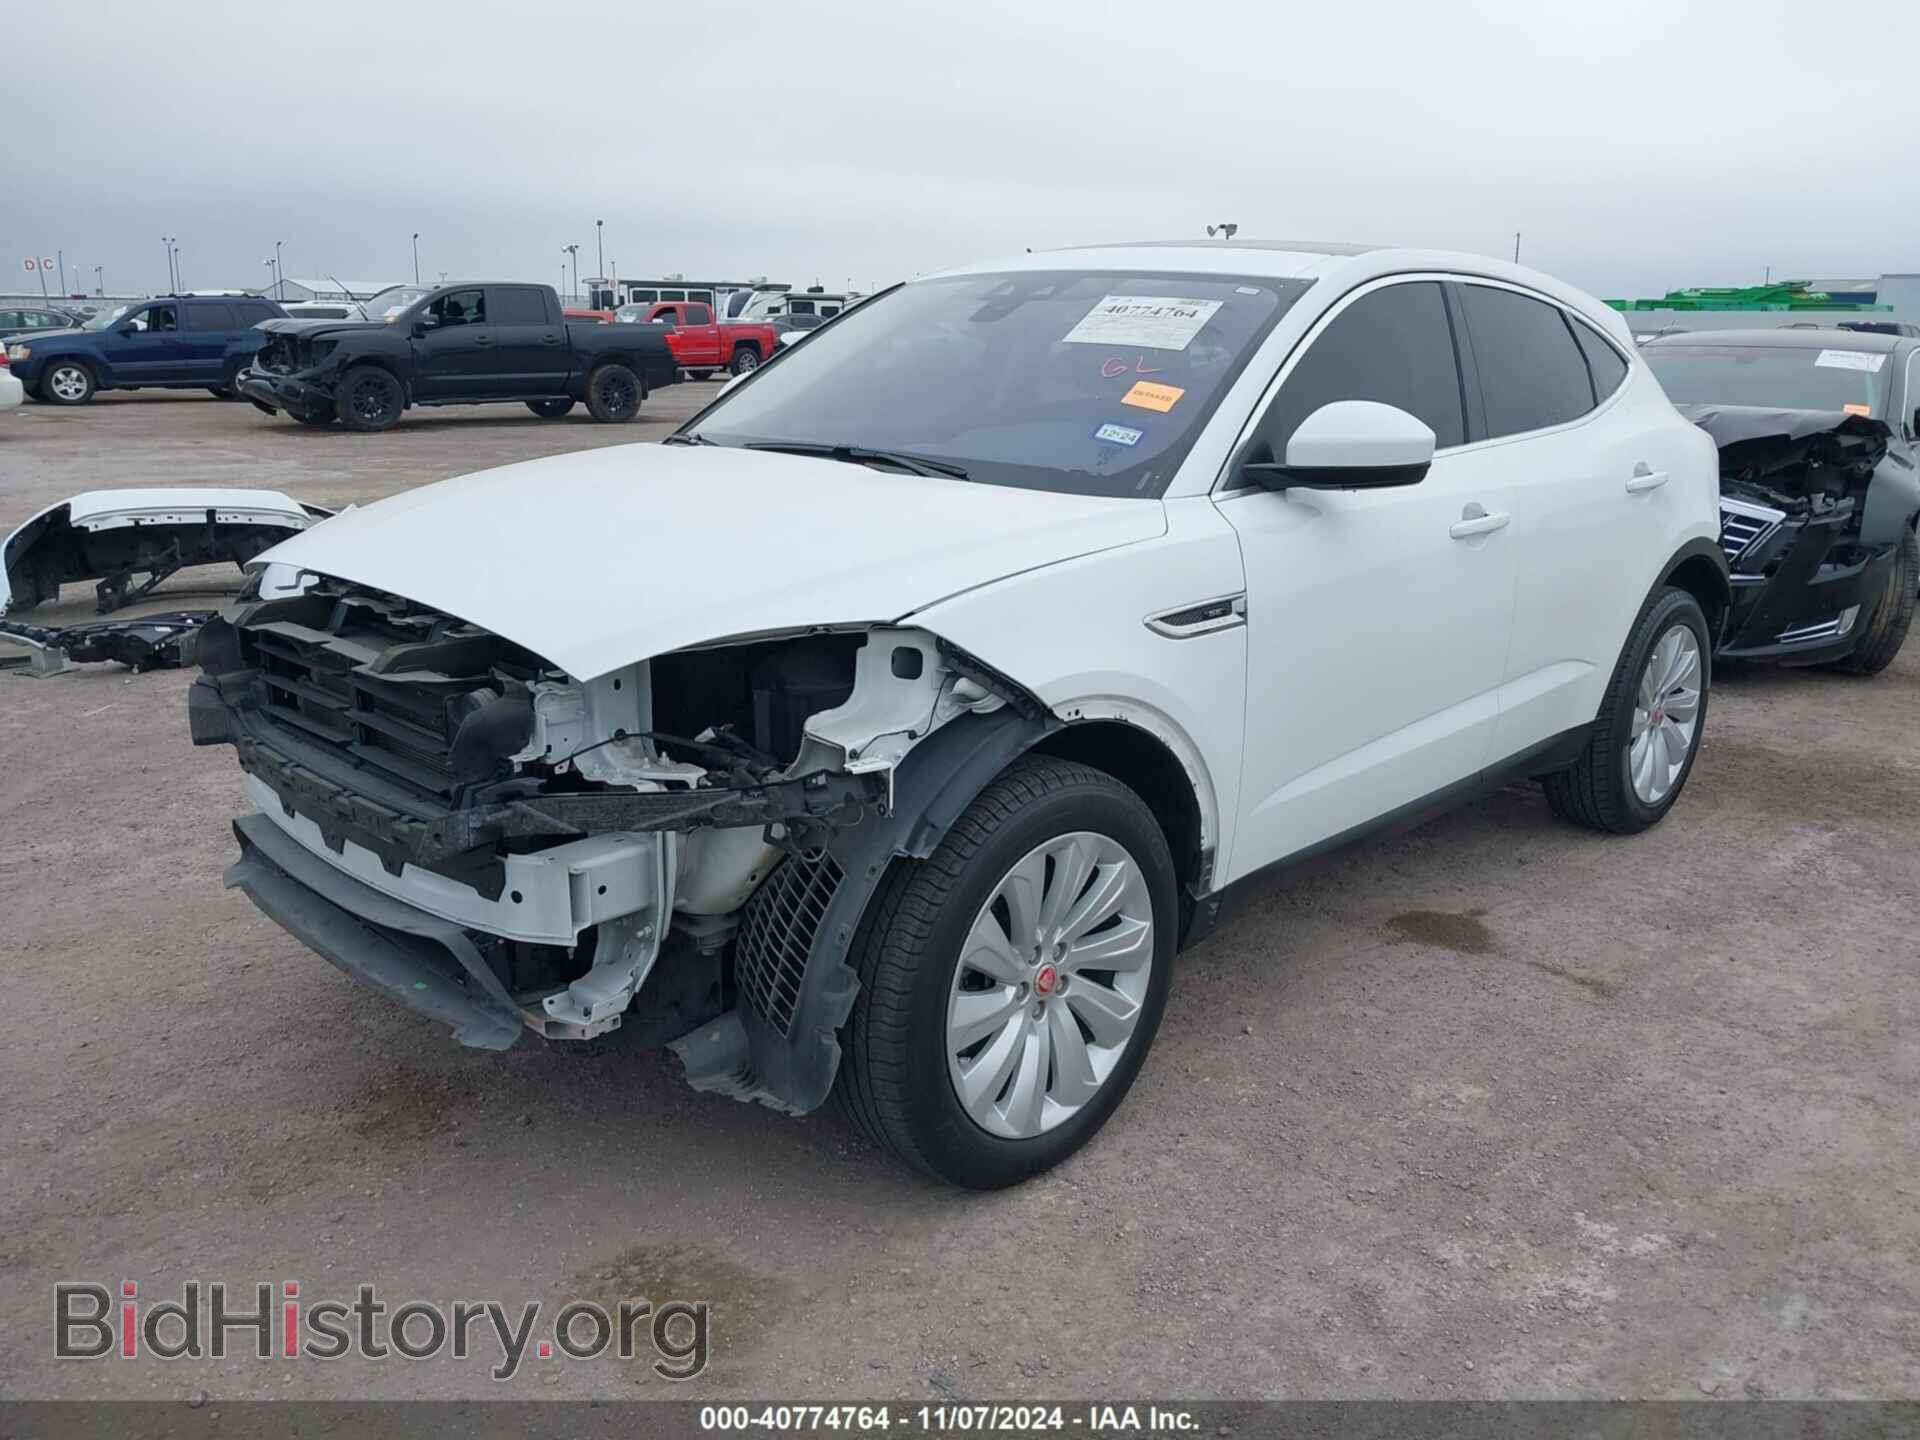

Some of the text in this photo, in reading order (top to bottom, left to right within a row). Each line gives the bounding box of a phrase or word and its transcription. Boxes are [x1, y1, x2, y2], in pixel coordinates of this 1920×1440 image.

[24, 260, 35, 271] D
[43, 259, 54, 270] C
[1104, 304, 1199, 318] 40774764
